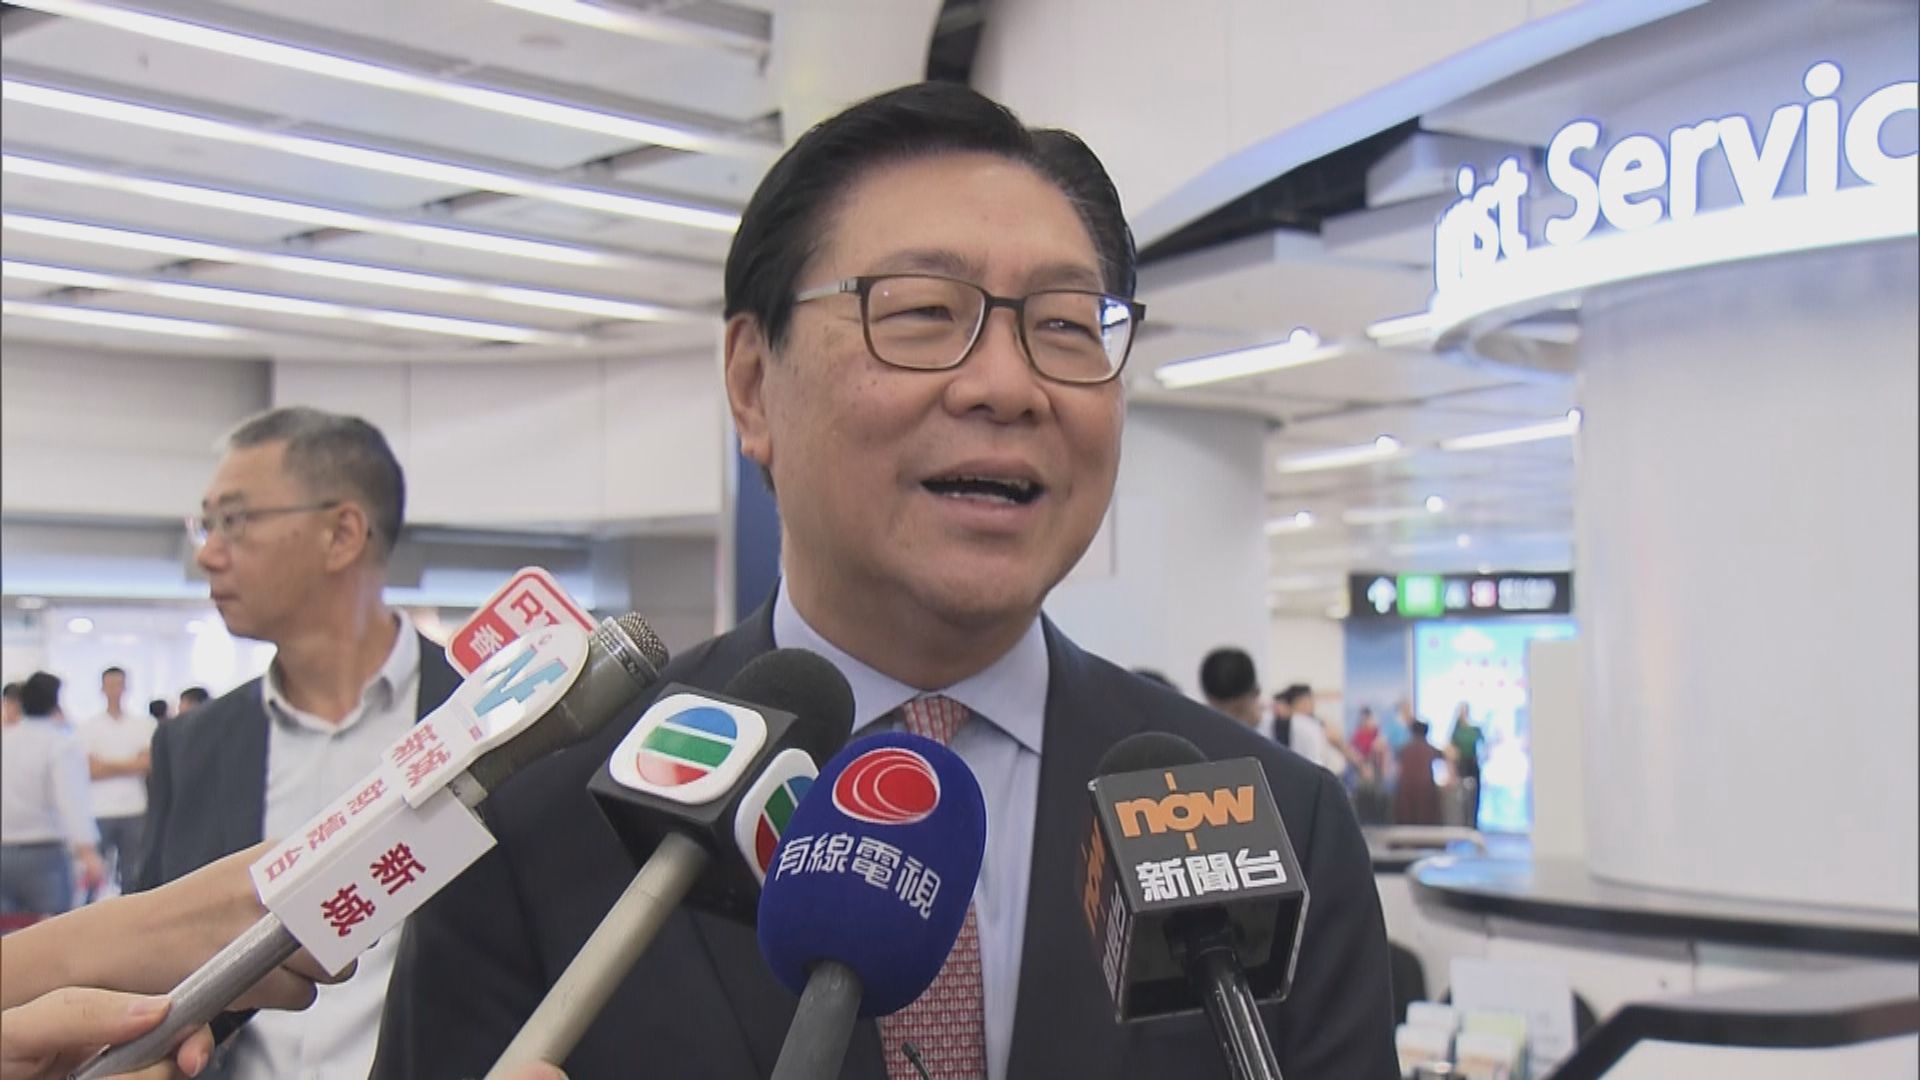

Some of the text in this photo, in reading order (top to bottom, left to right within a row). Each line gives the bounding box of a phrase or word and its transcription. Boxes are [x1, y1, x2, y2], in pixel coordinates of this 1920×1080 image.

[1115, 785, 1255, 838] now
[320, 842, 426, 938] 新城
[775, 832, 942, 920] 有線電視
[1135, 848, 1288, 902] 新聞台
